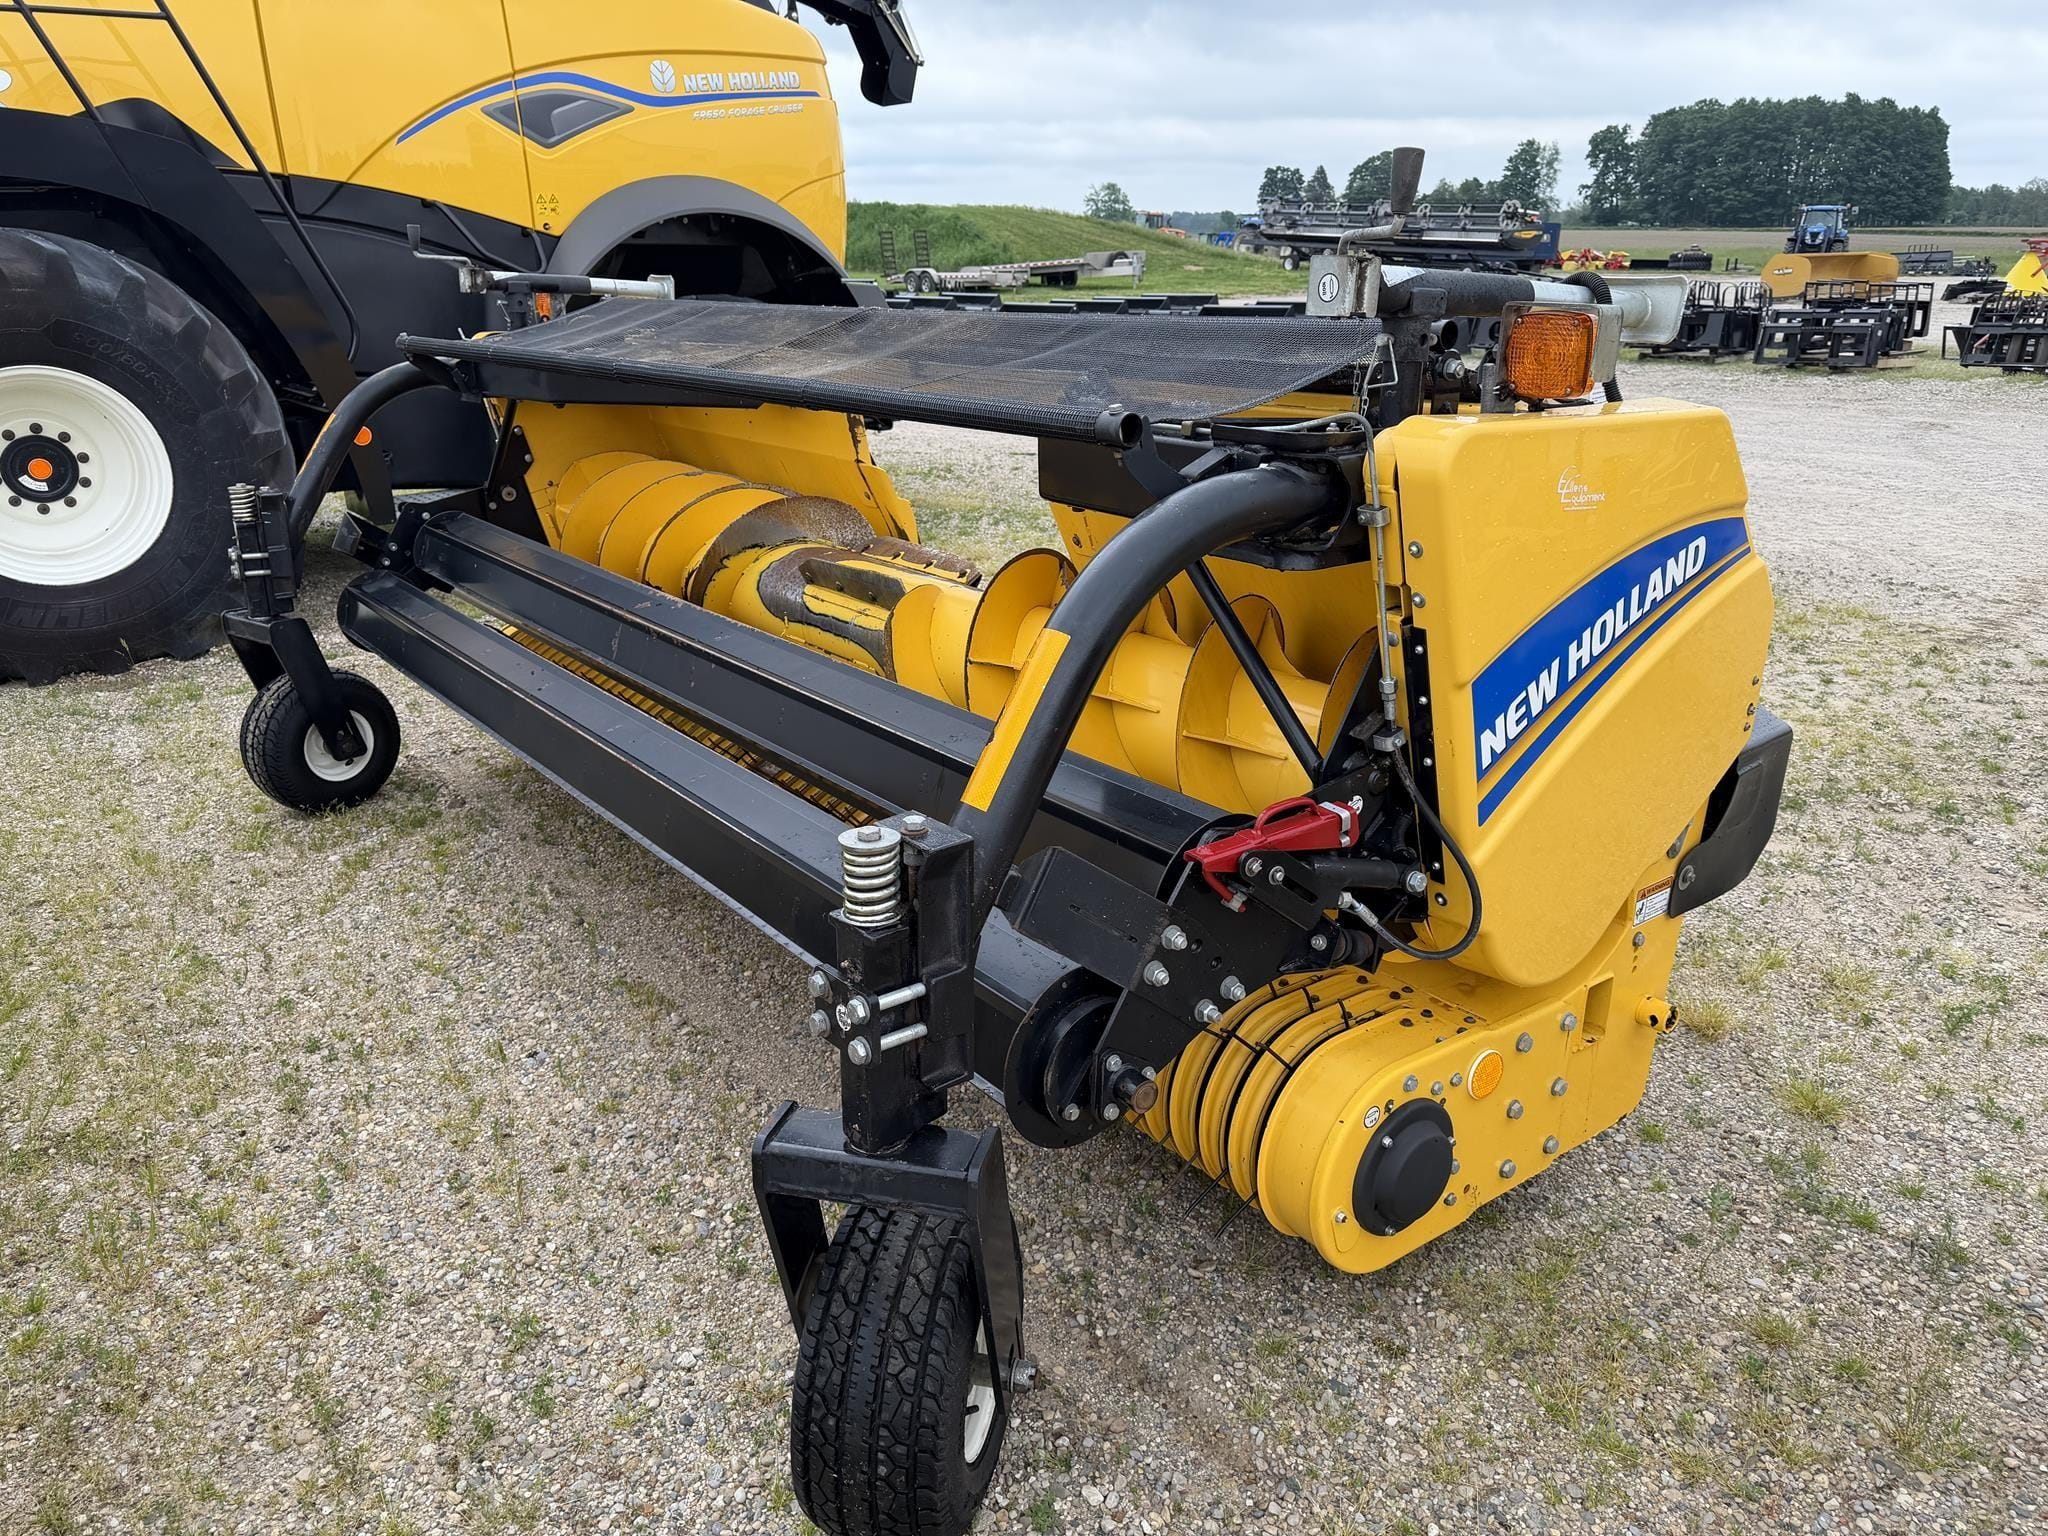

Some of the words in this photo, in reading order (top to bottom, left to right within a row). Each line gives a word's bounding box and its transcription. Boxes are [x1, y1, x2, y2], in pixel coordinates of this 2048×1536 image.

[684, 73, 724, 93] NEW
[728, 71, 801, 90] HOLLAND
[727, 106, 766, 118] FORAGE
[767, 103, 804, 114] CRUISER
[1480, 656, 1562, 771] NEW
[1567, 534, 1707, 684] HOLLAND
